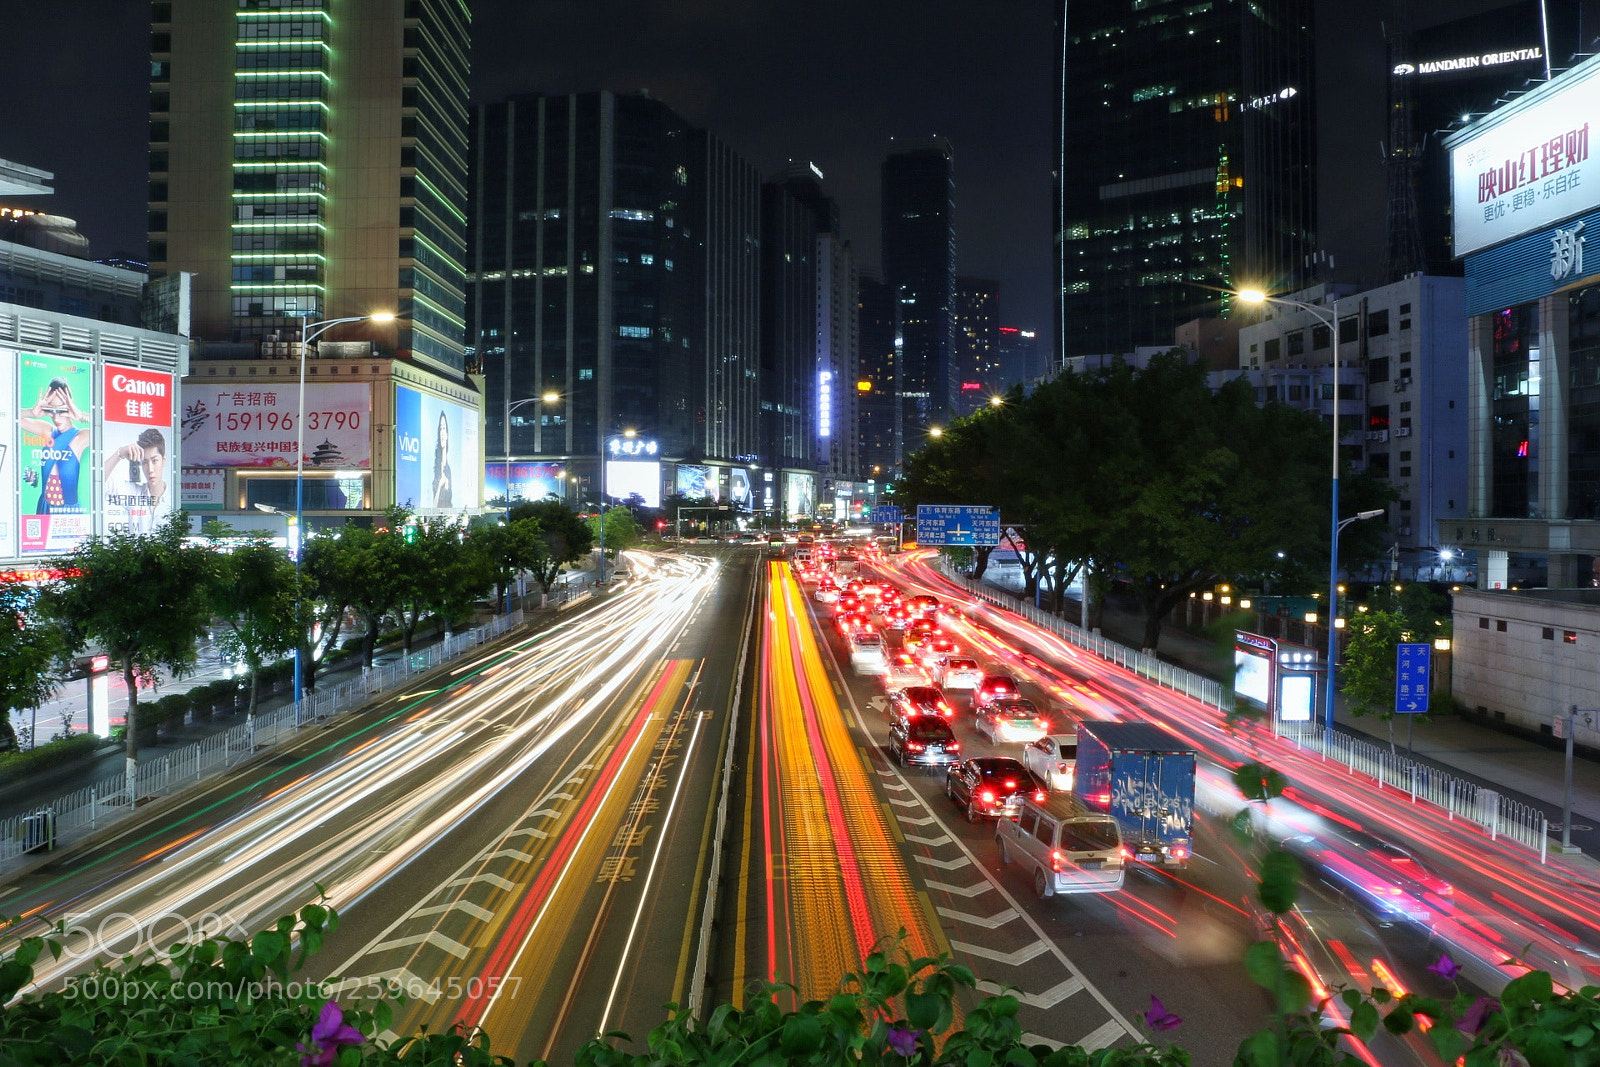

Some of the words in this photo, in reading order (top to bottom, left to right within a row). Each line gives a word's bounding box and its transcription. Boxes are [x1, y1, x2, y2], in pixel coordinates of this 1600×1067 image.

[1419, 56, 1480, 74] MANDARIN
[1482, 48, 1542, 66] ORIENTAL
[1478, 122, 1589, 204] 映山红理财
[1550, 221, 1586, 280] 新
[112, 374, 165, 397] Canon
[125, 399, 153, 418] 佳能
[216, 392, 277, 406] 广告招商
[215, 411, 360, 431] 1591963790
[24, 431, 55, 448] hello
[399, 432, 419, 453] vivo
[1400, 647, 1411, 693] 天河东路
